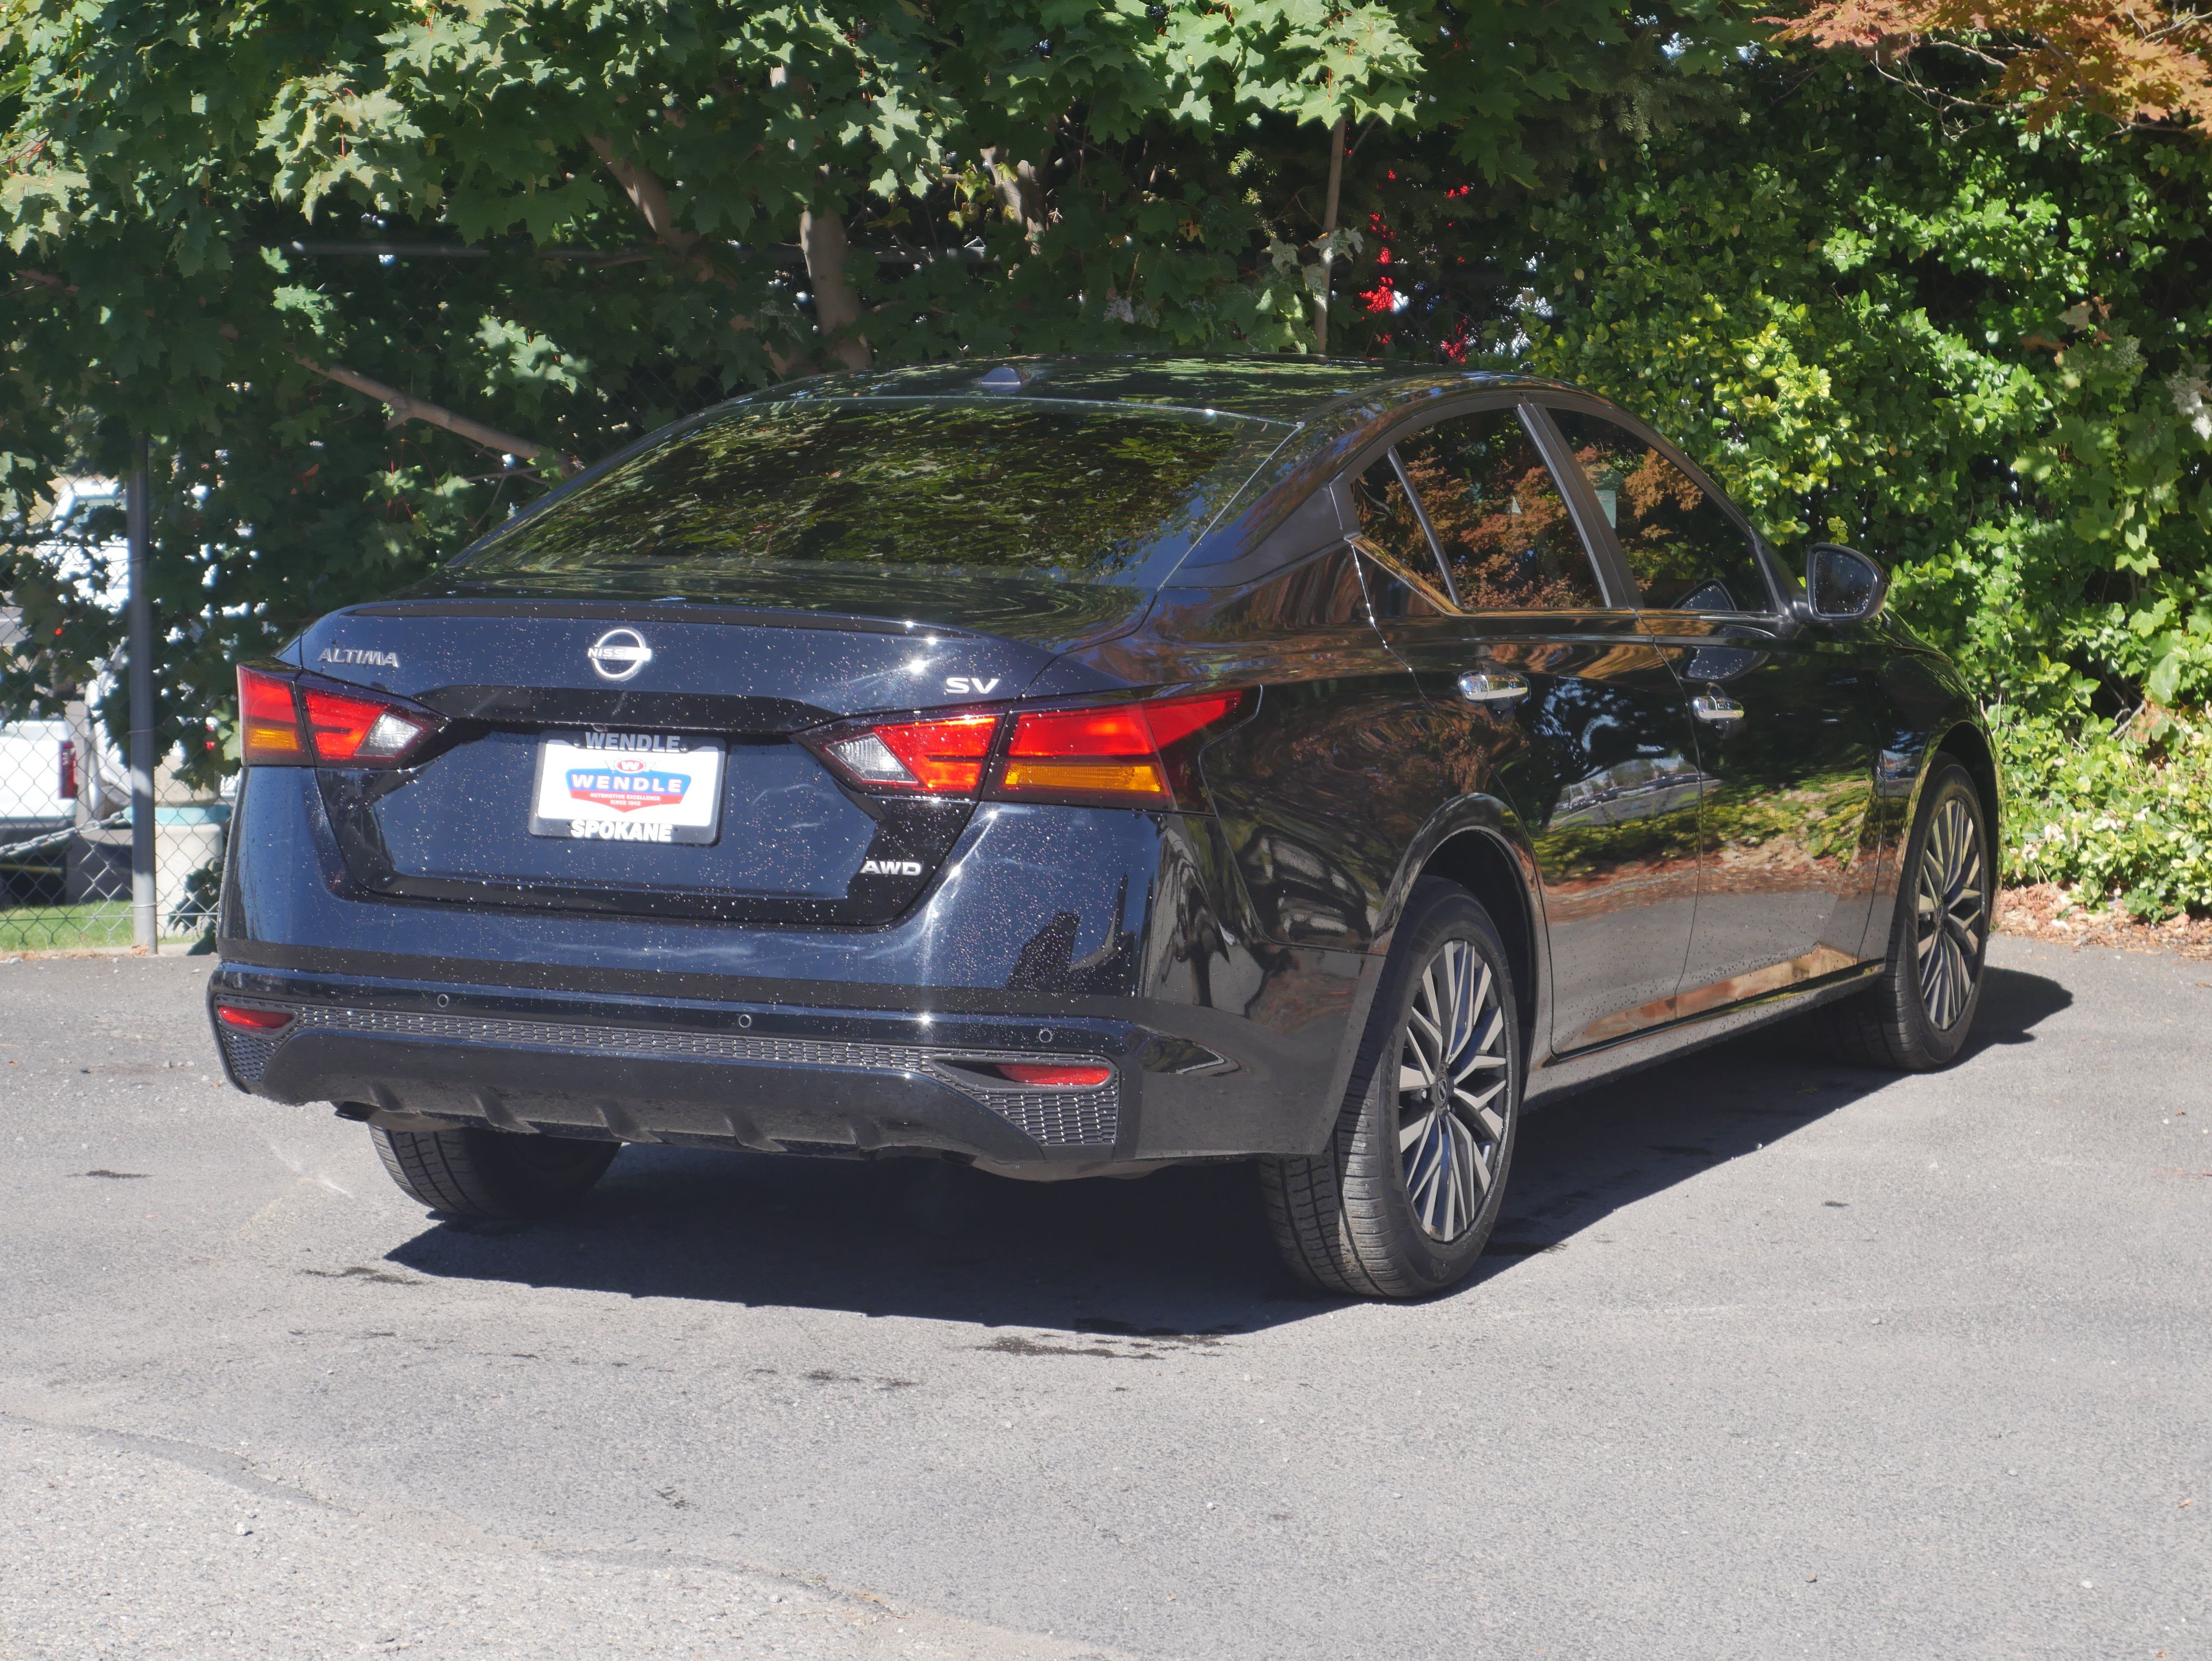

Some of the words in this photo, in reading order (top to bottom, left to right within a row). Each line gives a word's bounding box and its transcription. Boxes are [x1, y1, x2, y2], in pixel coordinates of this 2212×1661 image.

[317, 648, 399, 668] ALTIMA
[588, 647, 649, 659] NISS
[946, 677, 1000, 694] SV
[585, 731, 681, 753] WENDLE
[621, 761, 640, 771] W
[571, 774, 682, 793] WENDLE
[570, 819, 673, 842] SPOKANE
[859, 860, 922, 876] AWD
